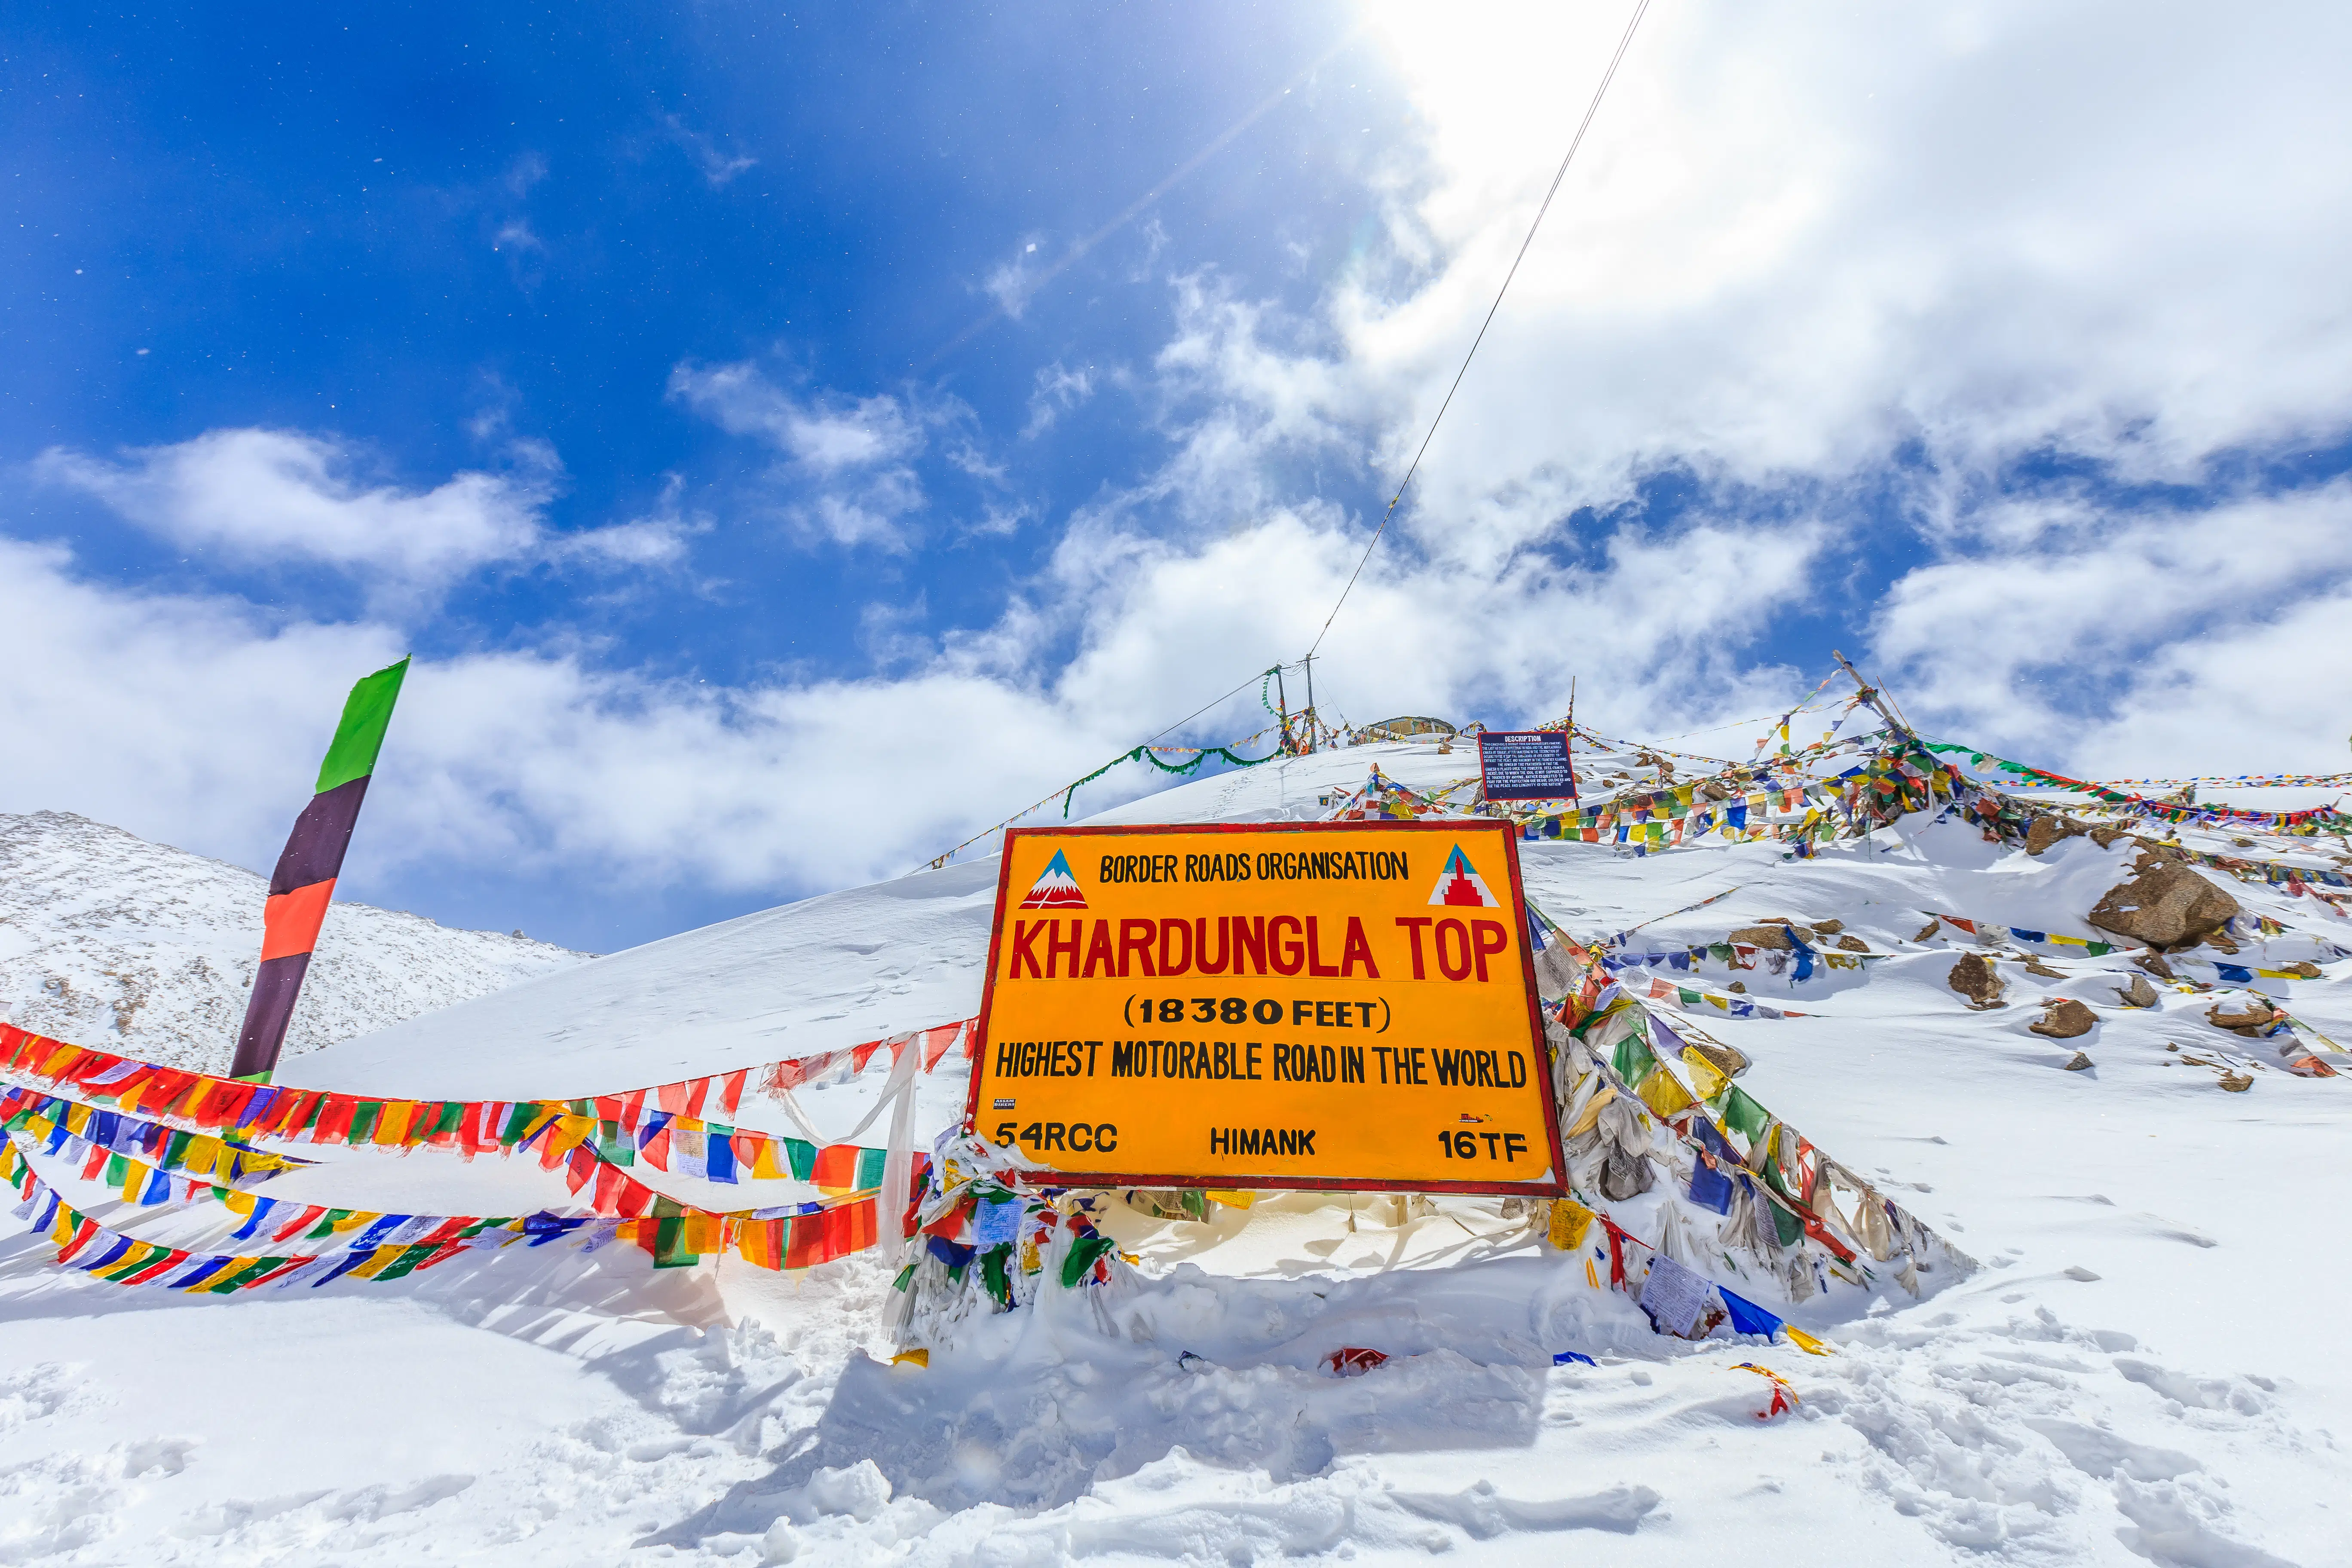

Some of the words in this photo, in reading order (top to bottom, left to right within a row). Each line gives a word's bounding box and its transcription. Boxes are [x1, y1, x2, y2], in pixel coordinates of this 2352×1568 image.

[1099, 854, 1178, 883] BORDER
[1185, 853, 1251, 882] ROADS
[1256, 851, 1409, 881] ORGANISATION
[1009, 915, 1381, 979] KHARDUNGLA
[1395, 917, 1508, 983] TOP
[1124, 994, 1283, 1029] (18380
[1292, 996, 1390, 1034] FEET)
[995, 1041, 1104, 1078] HIGHEST
[1111, 1040, 1262, 1080] MOTORABLE
[1371, 1046, 1428, 1085] THE
[1430, 1048, 1527, 1088] WORLD
[994, 1122, 1118, 1153] 54RCC
[1210, 1127, 1316, 1157] HIMANK
[1438, 1130, 1528, 1163] 16TF
